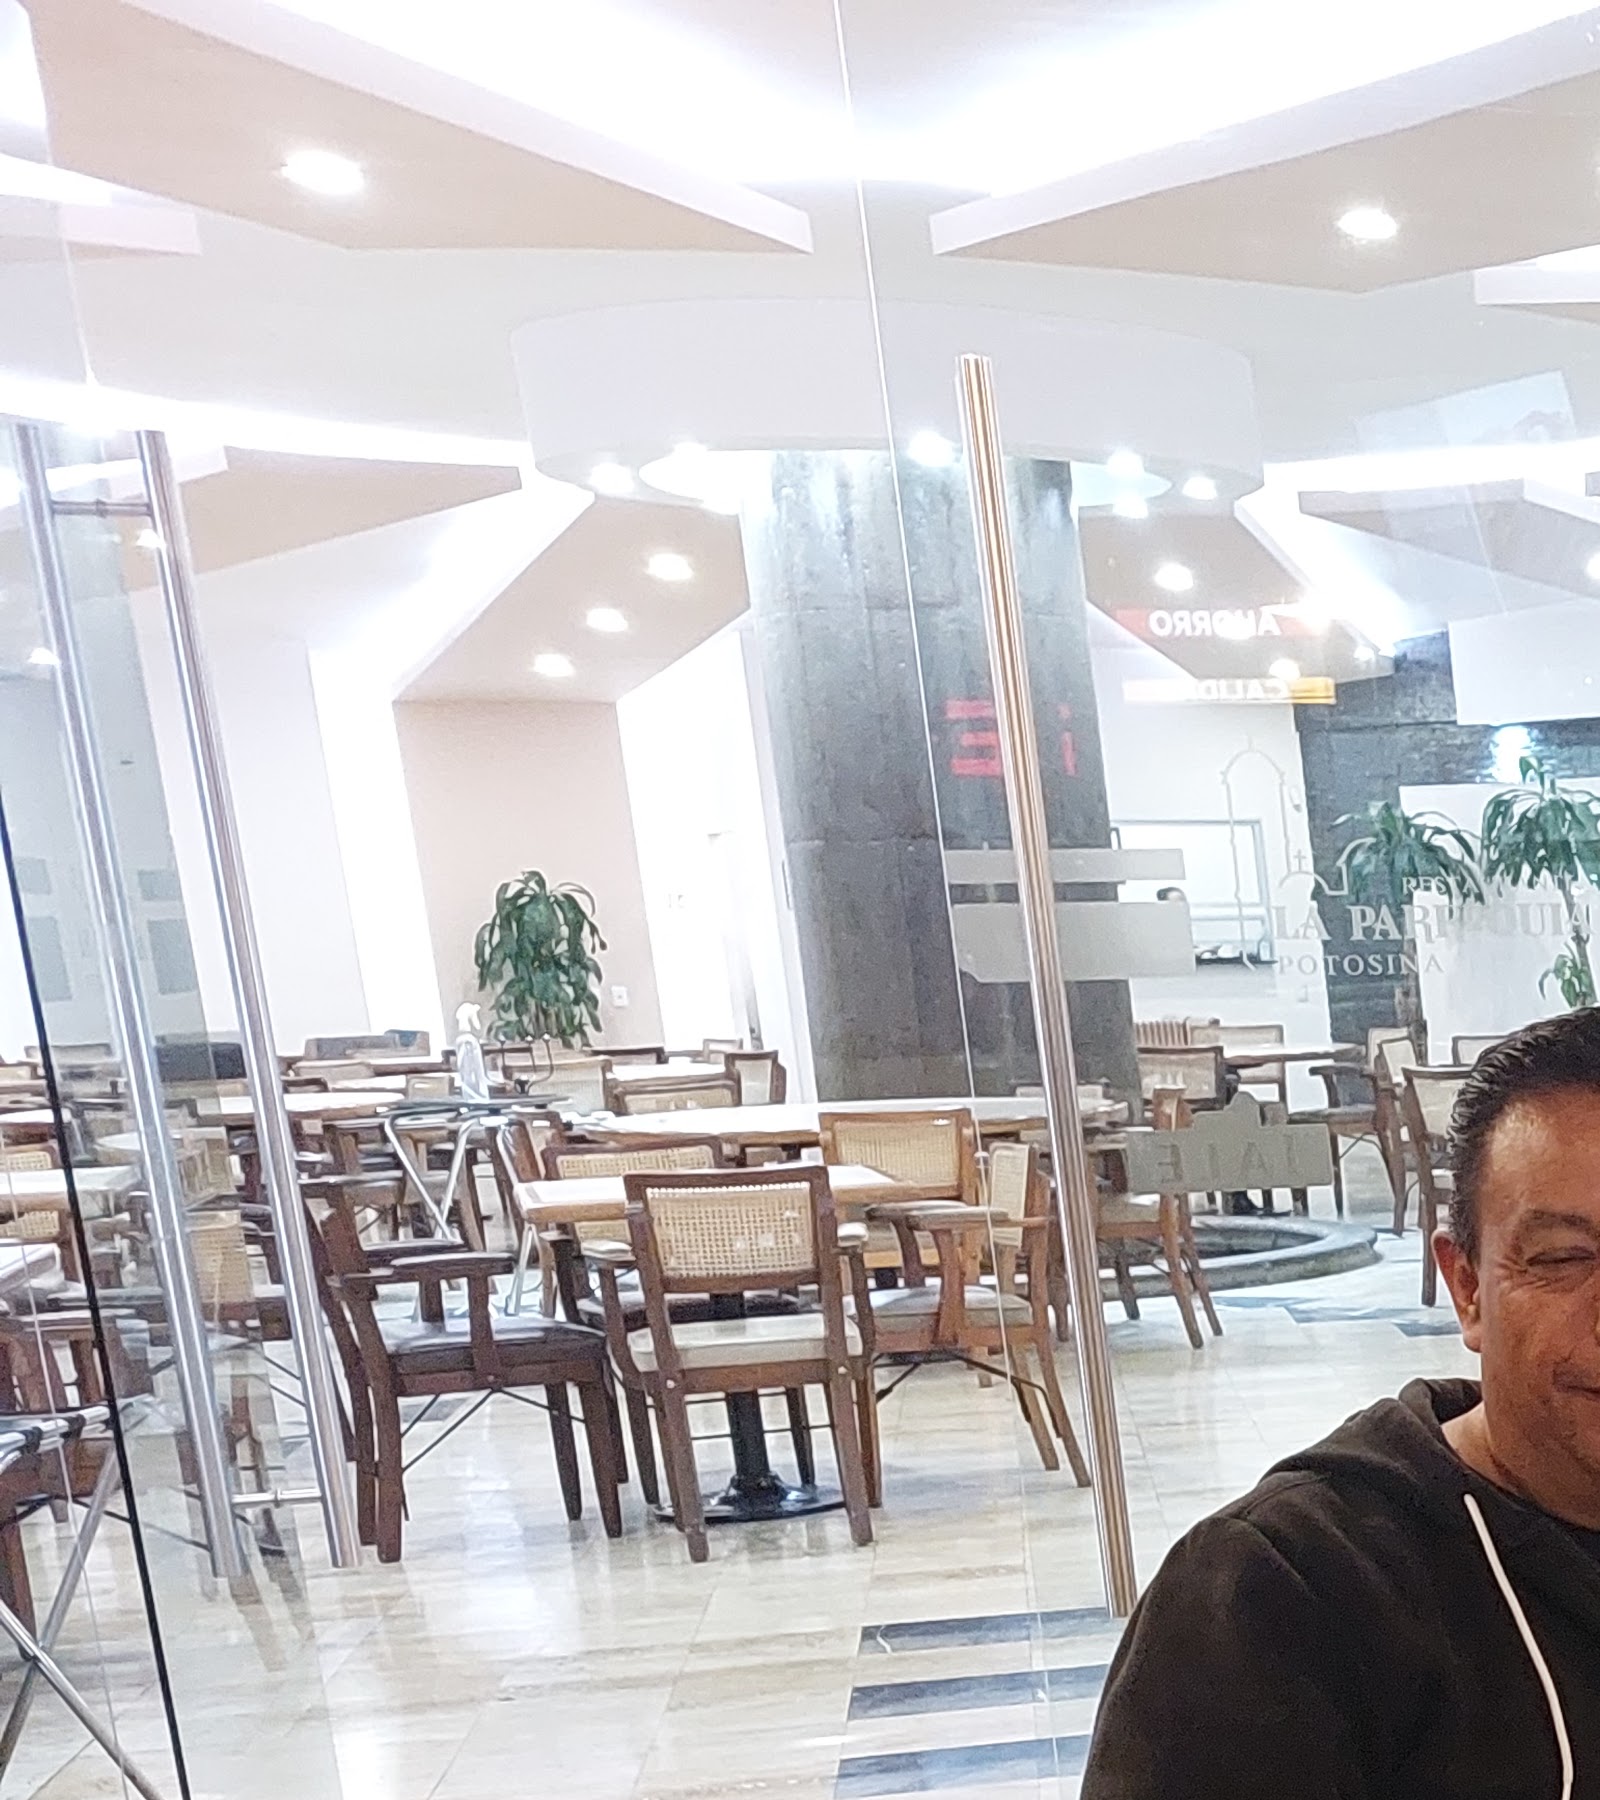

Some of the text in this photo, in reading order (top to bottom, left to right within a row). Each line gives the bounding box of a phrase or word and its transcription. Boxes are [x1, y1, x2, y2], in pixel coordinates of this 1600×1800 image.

[1273, 904, 1597, 943] LA PARUIA
[1279, 953, 1444, 976] POTOSINA
